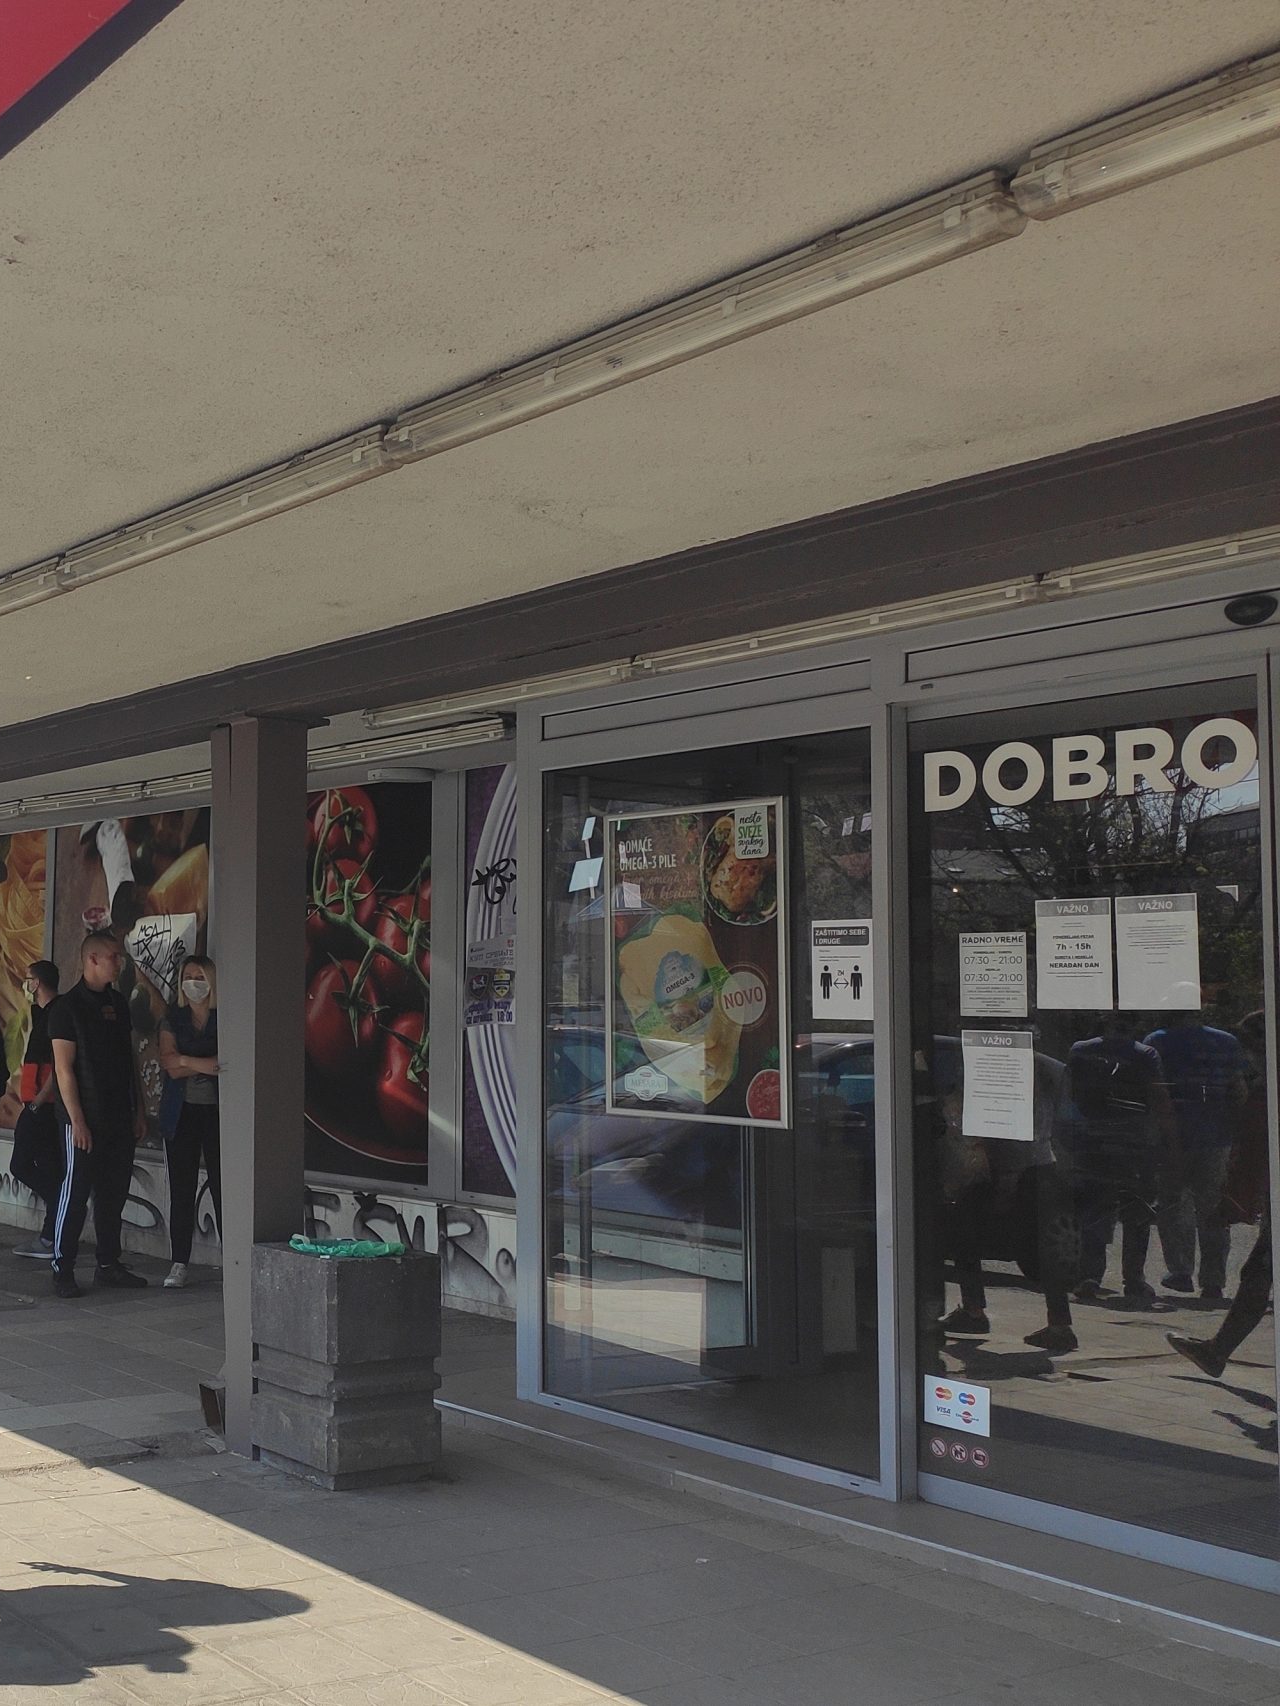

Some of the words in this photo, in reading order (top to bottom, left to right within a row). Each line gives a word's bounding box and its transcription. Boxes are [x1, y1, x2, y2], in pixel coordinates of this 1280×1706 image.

[923, 717, 1258, 813] DOBRO
[741, 845, 762, 856] dana
[659, 854, 677, 869] PILE
[1056, 904, 1089, 914] VAŽNO
[1138, 900, 1173, 911] VAŽNO
[961, 936, 992, 944] RADNO
[994, 935, 1024, 943] VREME
[963, 956, 990, 965] 07:30
[998, 956, 1023, 965] 21:00
[963, 973, 990, 982] 07:30
[998, 973, 1023, 982] 21:00
[723, 986, 763, 1010] NOVO
[981, 1035, 1013, 1046] VAŽNO
[936, 1405, 951, 1415] VISA
